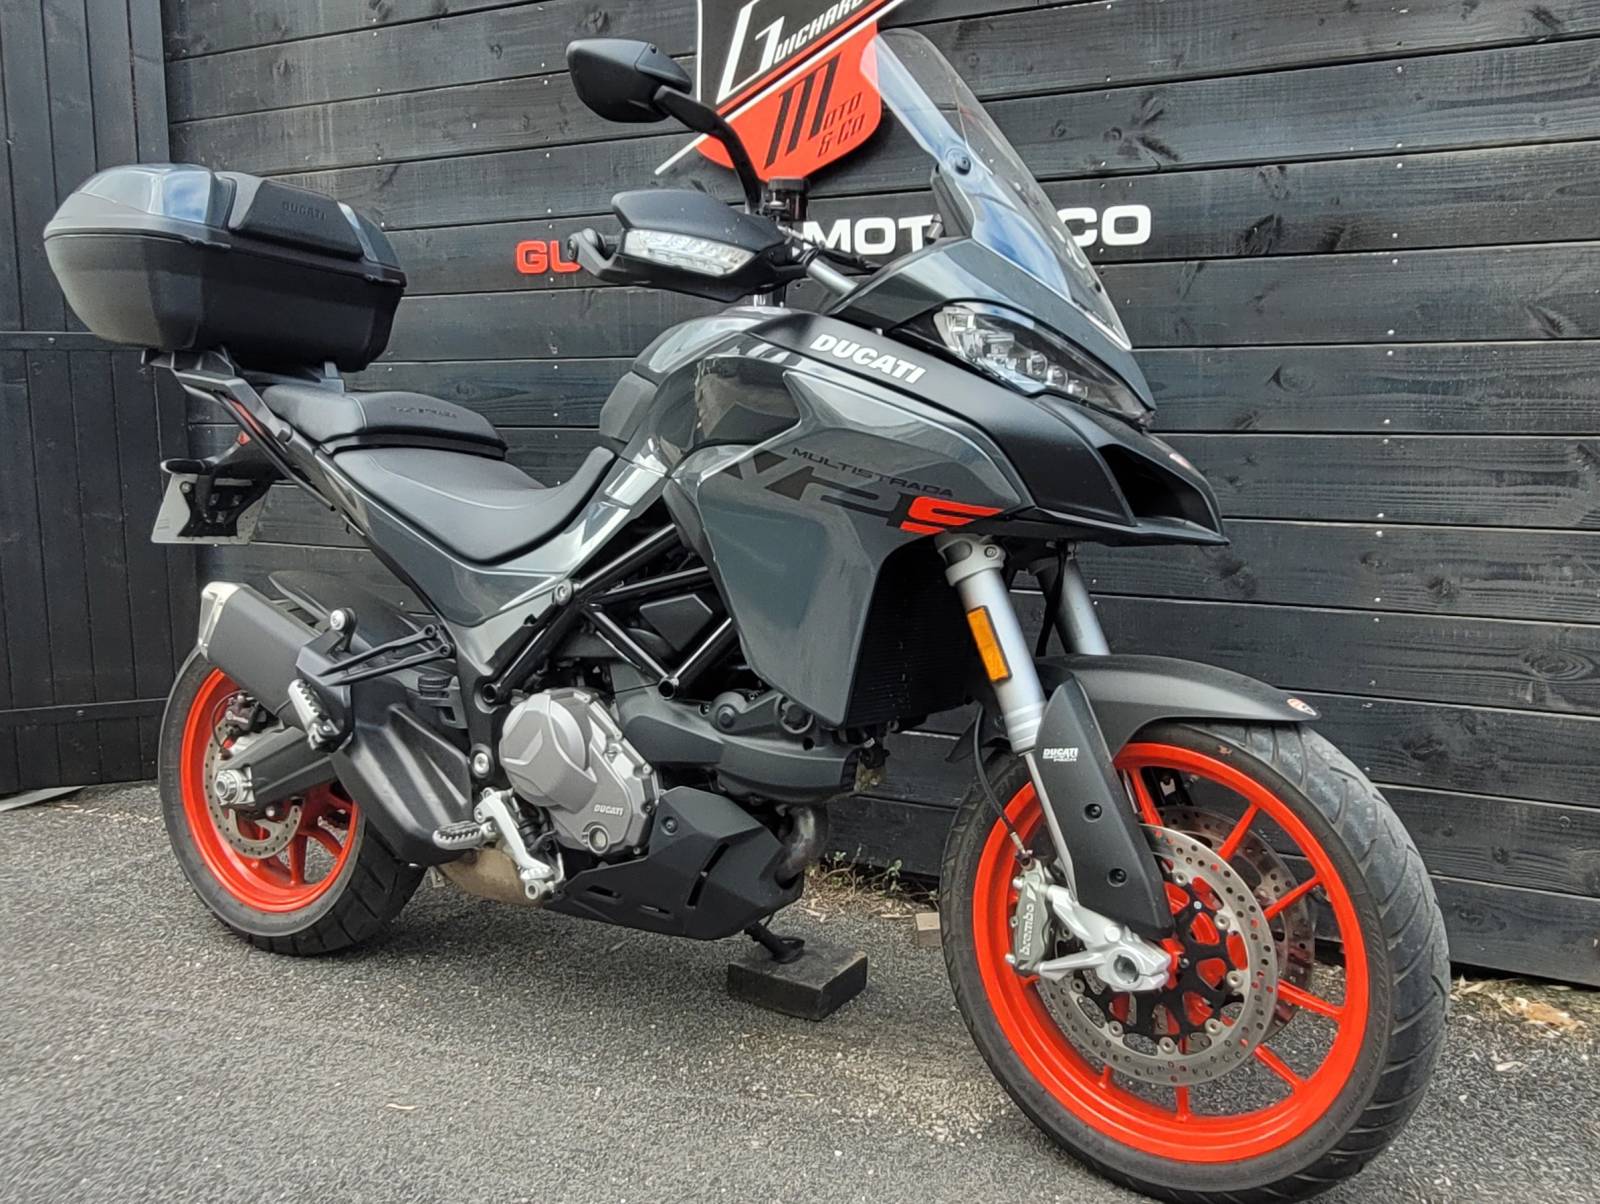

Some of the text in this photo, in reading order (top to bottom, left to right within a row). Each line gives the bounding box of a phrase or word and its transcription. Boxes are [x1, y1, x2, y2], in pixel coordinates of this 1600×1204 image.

[1056, 204, 1152, 248] CO
[810, 333, 927, 385] DUCATI
[791, 447, 954, 497] MULTISTRADA
[1042, 747, 1079, 760] DUCATI
[594, 803, 624, 817] DUCATI
[1019, 902, 1036, 957] brembo
